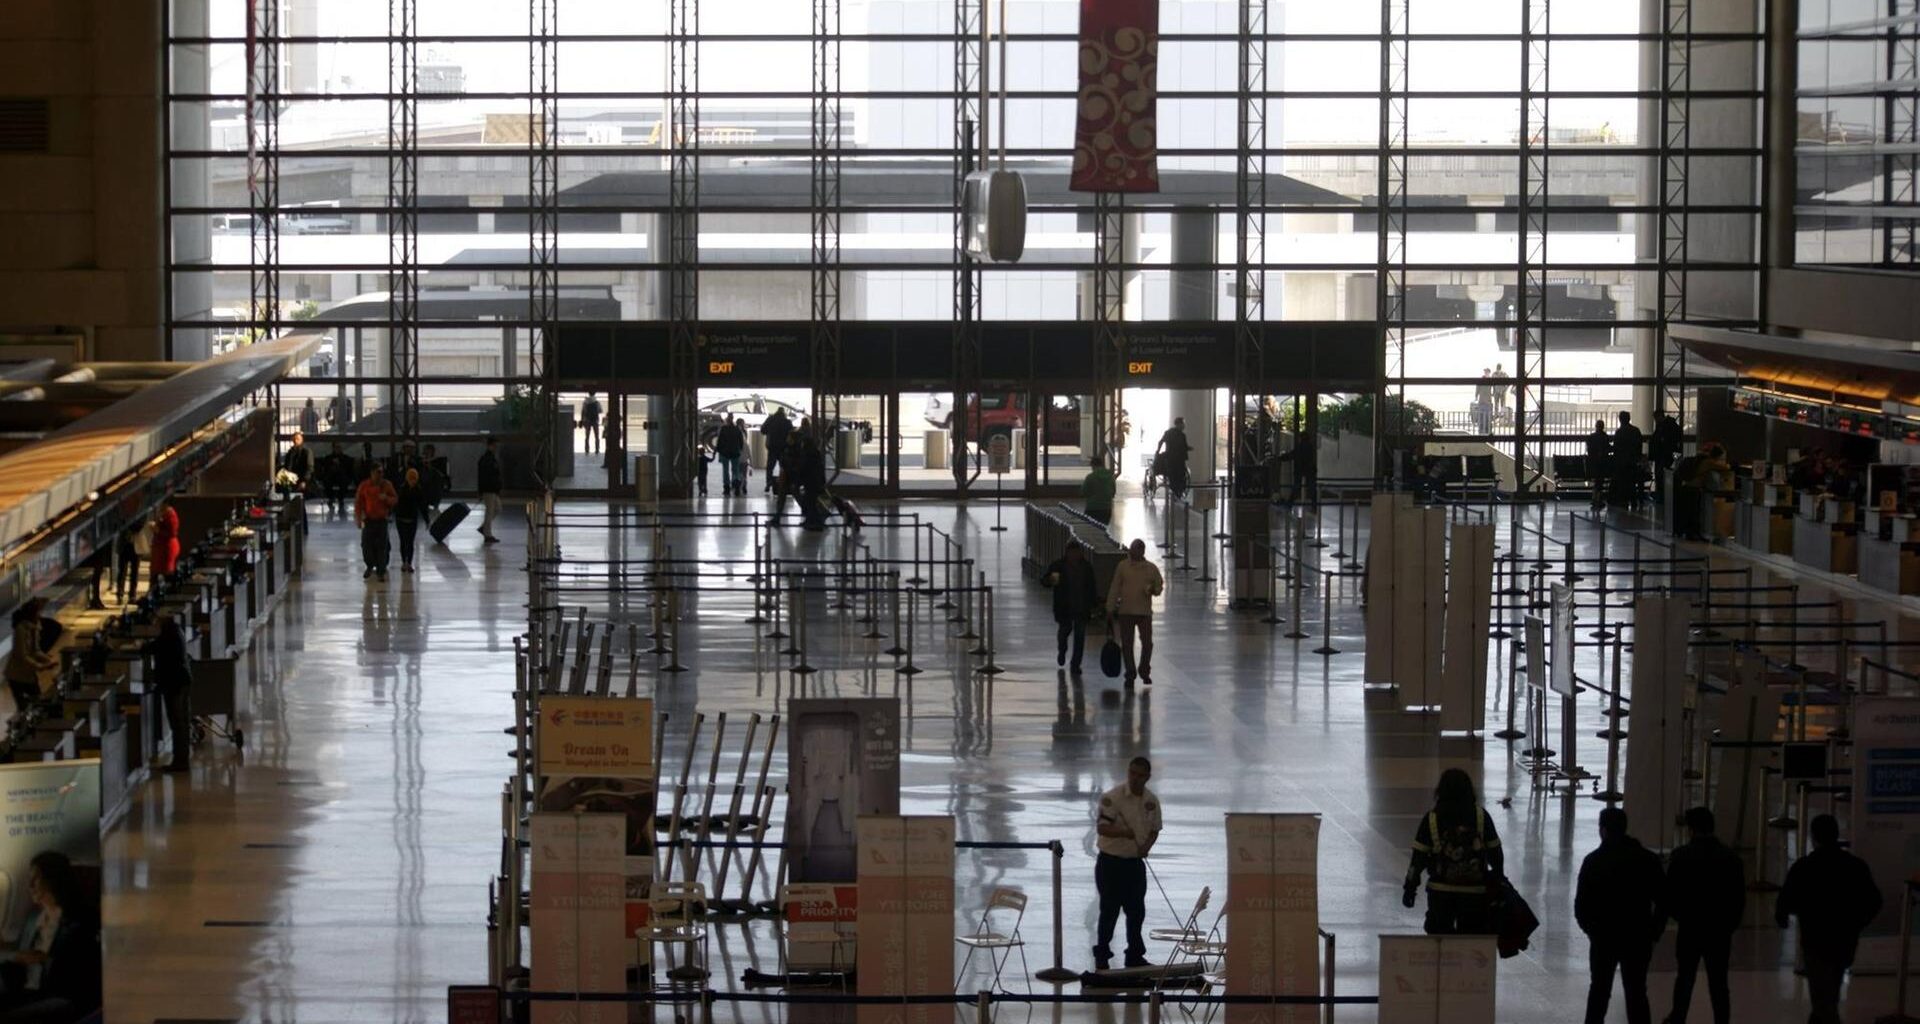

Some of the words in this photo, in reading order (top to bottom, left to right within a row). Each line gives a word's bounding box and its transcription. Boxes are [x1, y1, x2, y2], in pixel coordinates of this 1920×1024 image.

[710, 334, 738, 344] Ground
[741, 334, 799, 345] Transportation
[1129, 335, 1159, 344] Ground
[1160, 335, 1217, 345] Transportation
[720, 346, 745, 354] Lower
[746, 346, 768, 354] Level
[1139, 346, 1164, 354] Lower
[1166, 346, 1188, 354] Level
[709, 361, 735, 374] EXIT
[1128, 361, 1153, 374] EXIT
[562, 742, 606, 756] Dream
[610, 743, 630, 757] On
[1875, 782, 1913, 793] CLASS
[6, 813, 25, 825] THE
[8, 826, 23, 837] OF
